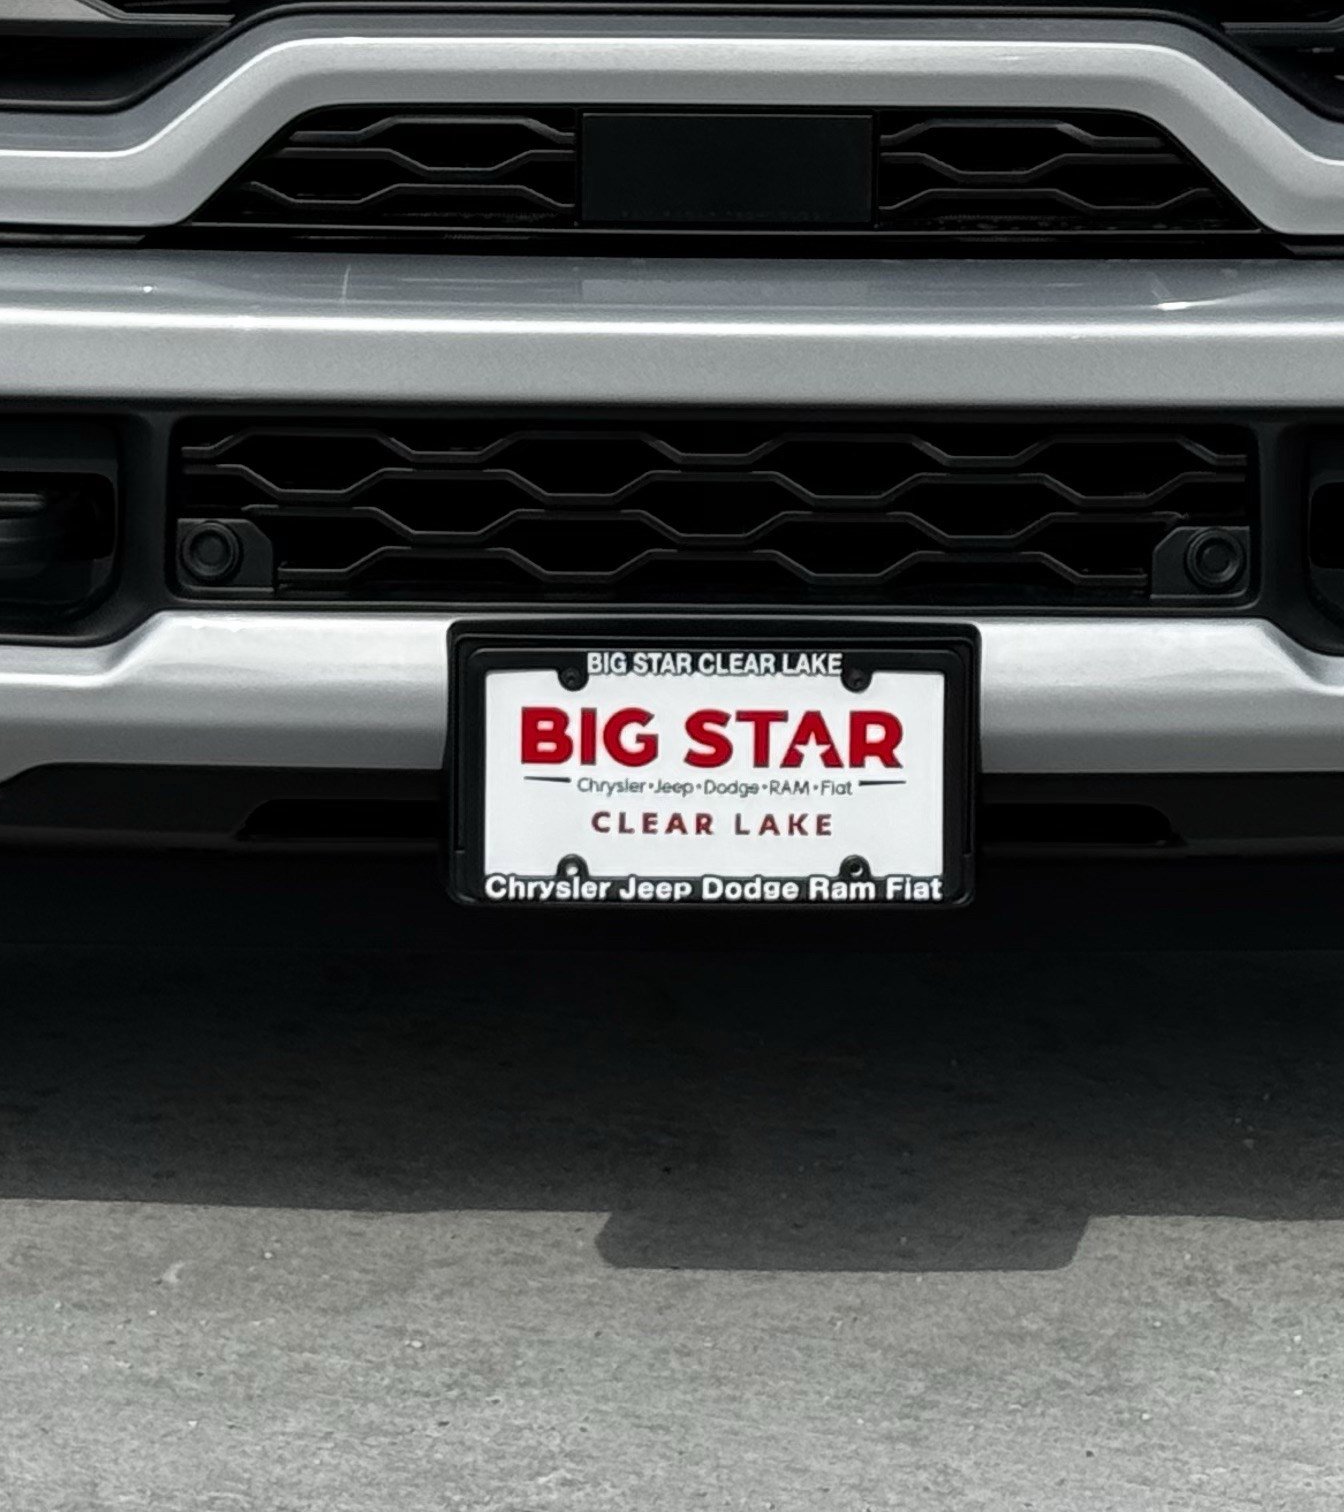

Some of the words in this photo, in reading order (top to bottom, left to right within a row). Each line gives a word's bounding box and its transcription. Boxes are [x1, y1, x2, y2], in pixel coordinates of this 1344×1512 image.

[586, 651, 627, 675] BIG
[632, 651, 692, 675] STAR
[698, 652, 776, 675] CLEAR
[782, 652, 843, 675] LAKE
[520, 706, 659, 767] BIG
[683, 708, 904, 769] STAR
[576, 776, 647, 798] Chrysler
[654, 778, 695, 798] Jeep
[704, 778, 760, 799] Dodge
[769, 780, 810, 796] RAM
[591, 810, 715, 836] CLEAR
[734, 812, 833, 837] LAKE
[484, 874, 611, 901] Chrysler
[619, 875, 693, 901] Jeep
[702, 876, 800, 901] Dodge
[808, 876, 877, 901] Ram
[885, 875, 944, 901] Fiat
